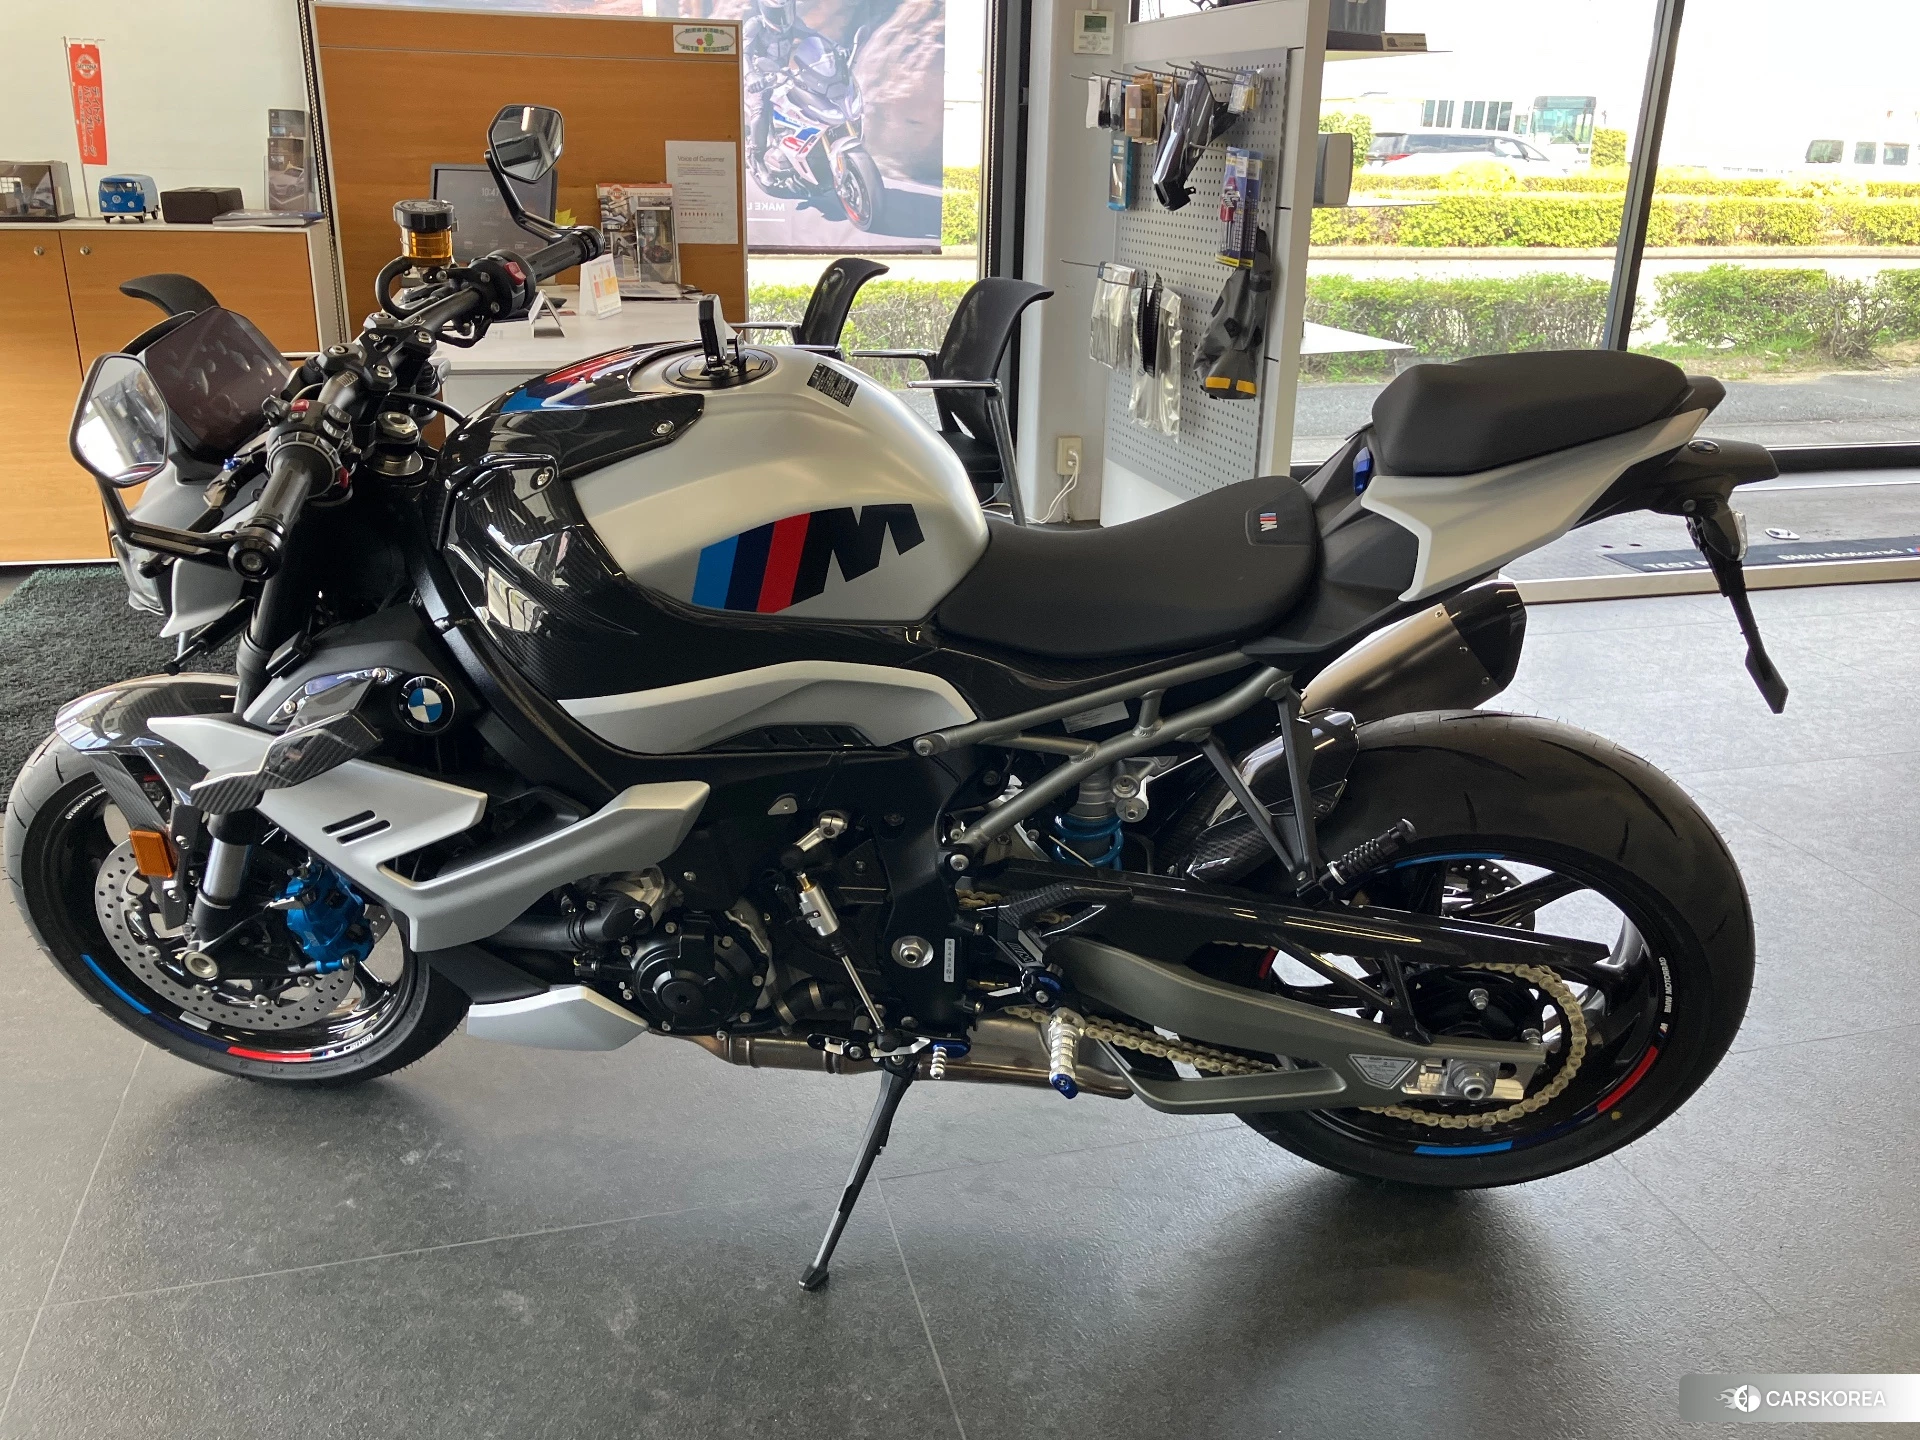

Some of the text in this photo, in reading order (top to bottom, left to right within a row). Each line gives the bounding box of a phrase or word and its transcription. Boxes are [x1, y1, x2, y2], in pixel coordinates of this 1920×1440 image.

[91, 86, 101, 124] デイトナ
[1642, 561, 1695, 570] TEST
[1777, 553, 1826, 561] BMW
[1659, 956, 1673, 996] MOTORRAD
[1663, 995, 1673, 1014] BMW
